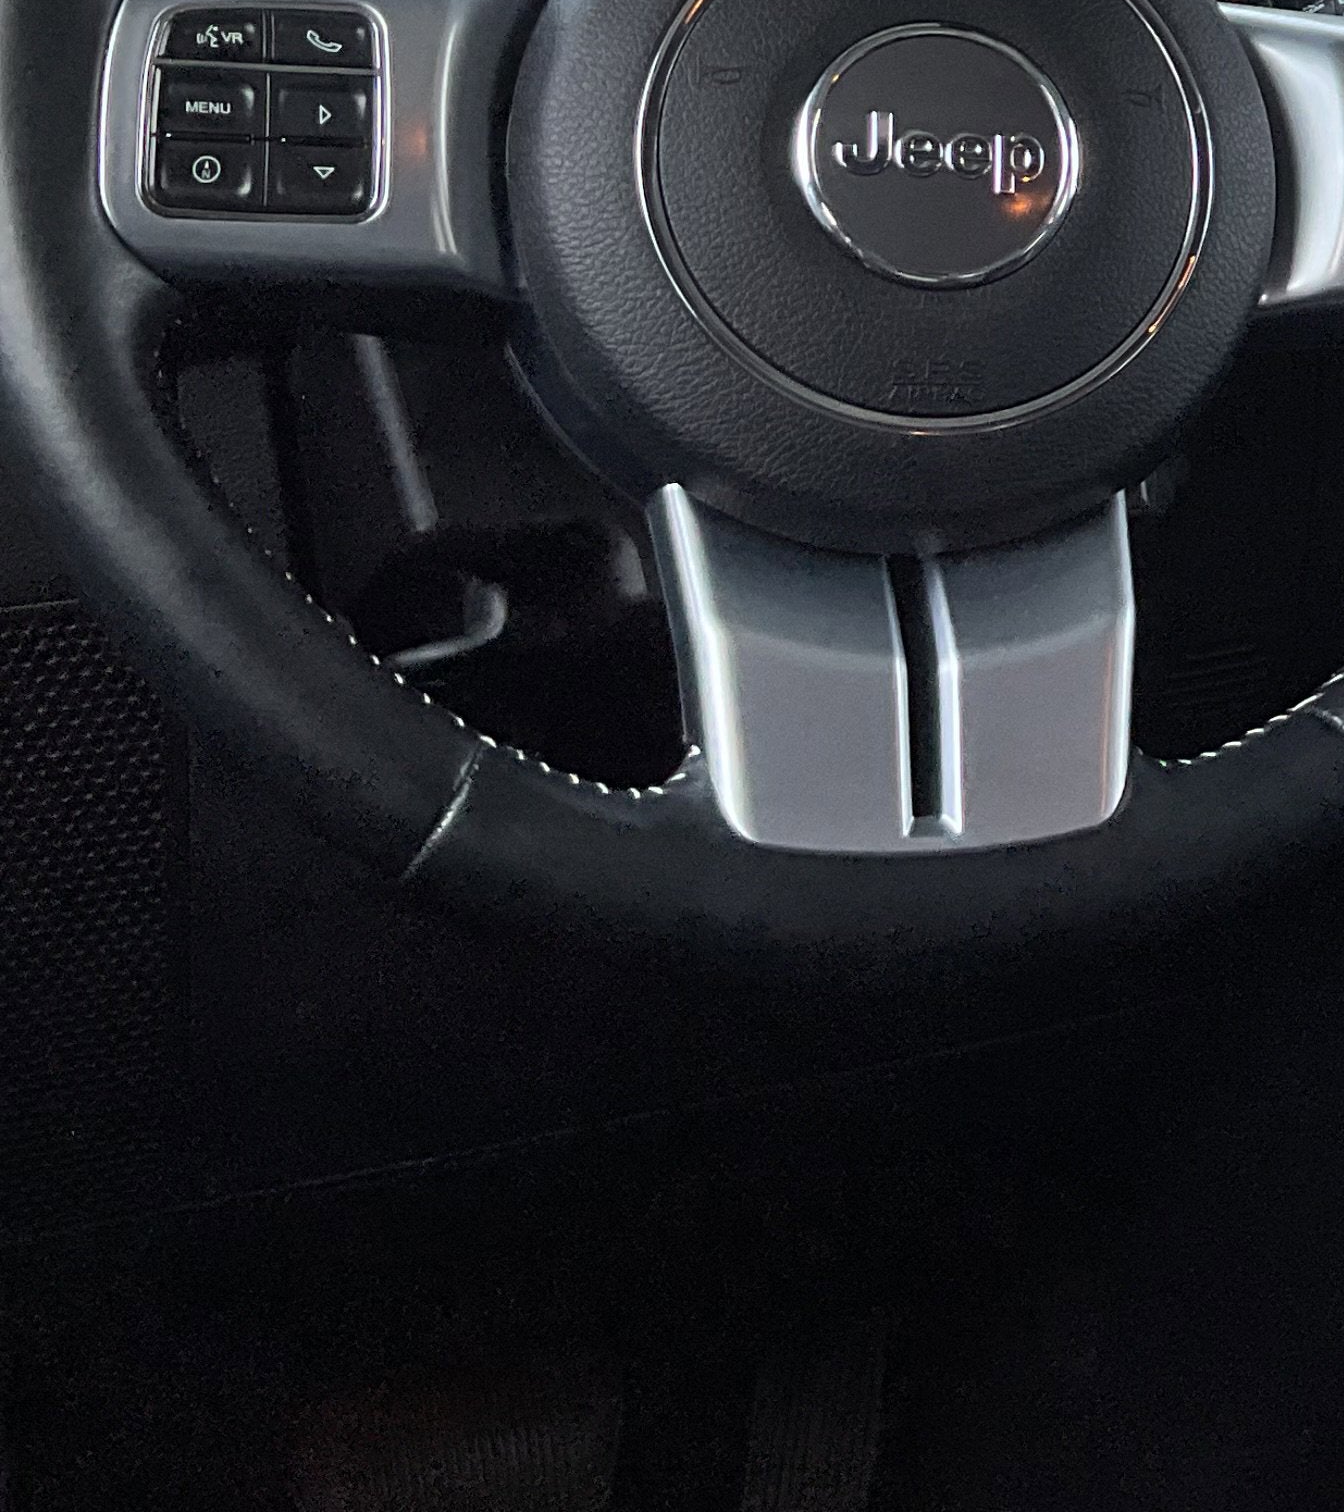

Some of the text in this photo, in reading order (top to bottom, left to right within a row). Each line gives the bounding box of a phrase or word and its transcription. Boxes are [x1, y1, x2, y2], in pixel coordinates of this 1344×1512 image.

[221, 31, 244, 45] VR
[185, 100, 231, 115] MENU
[832, 110, 1046, 194] Jeep
